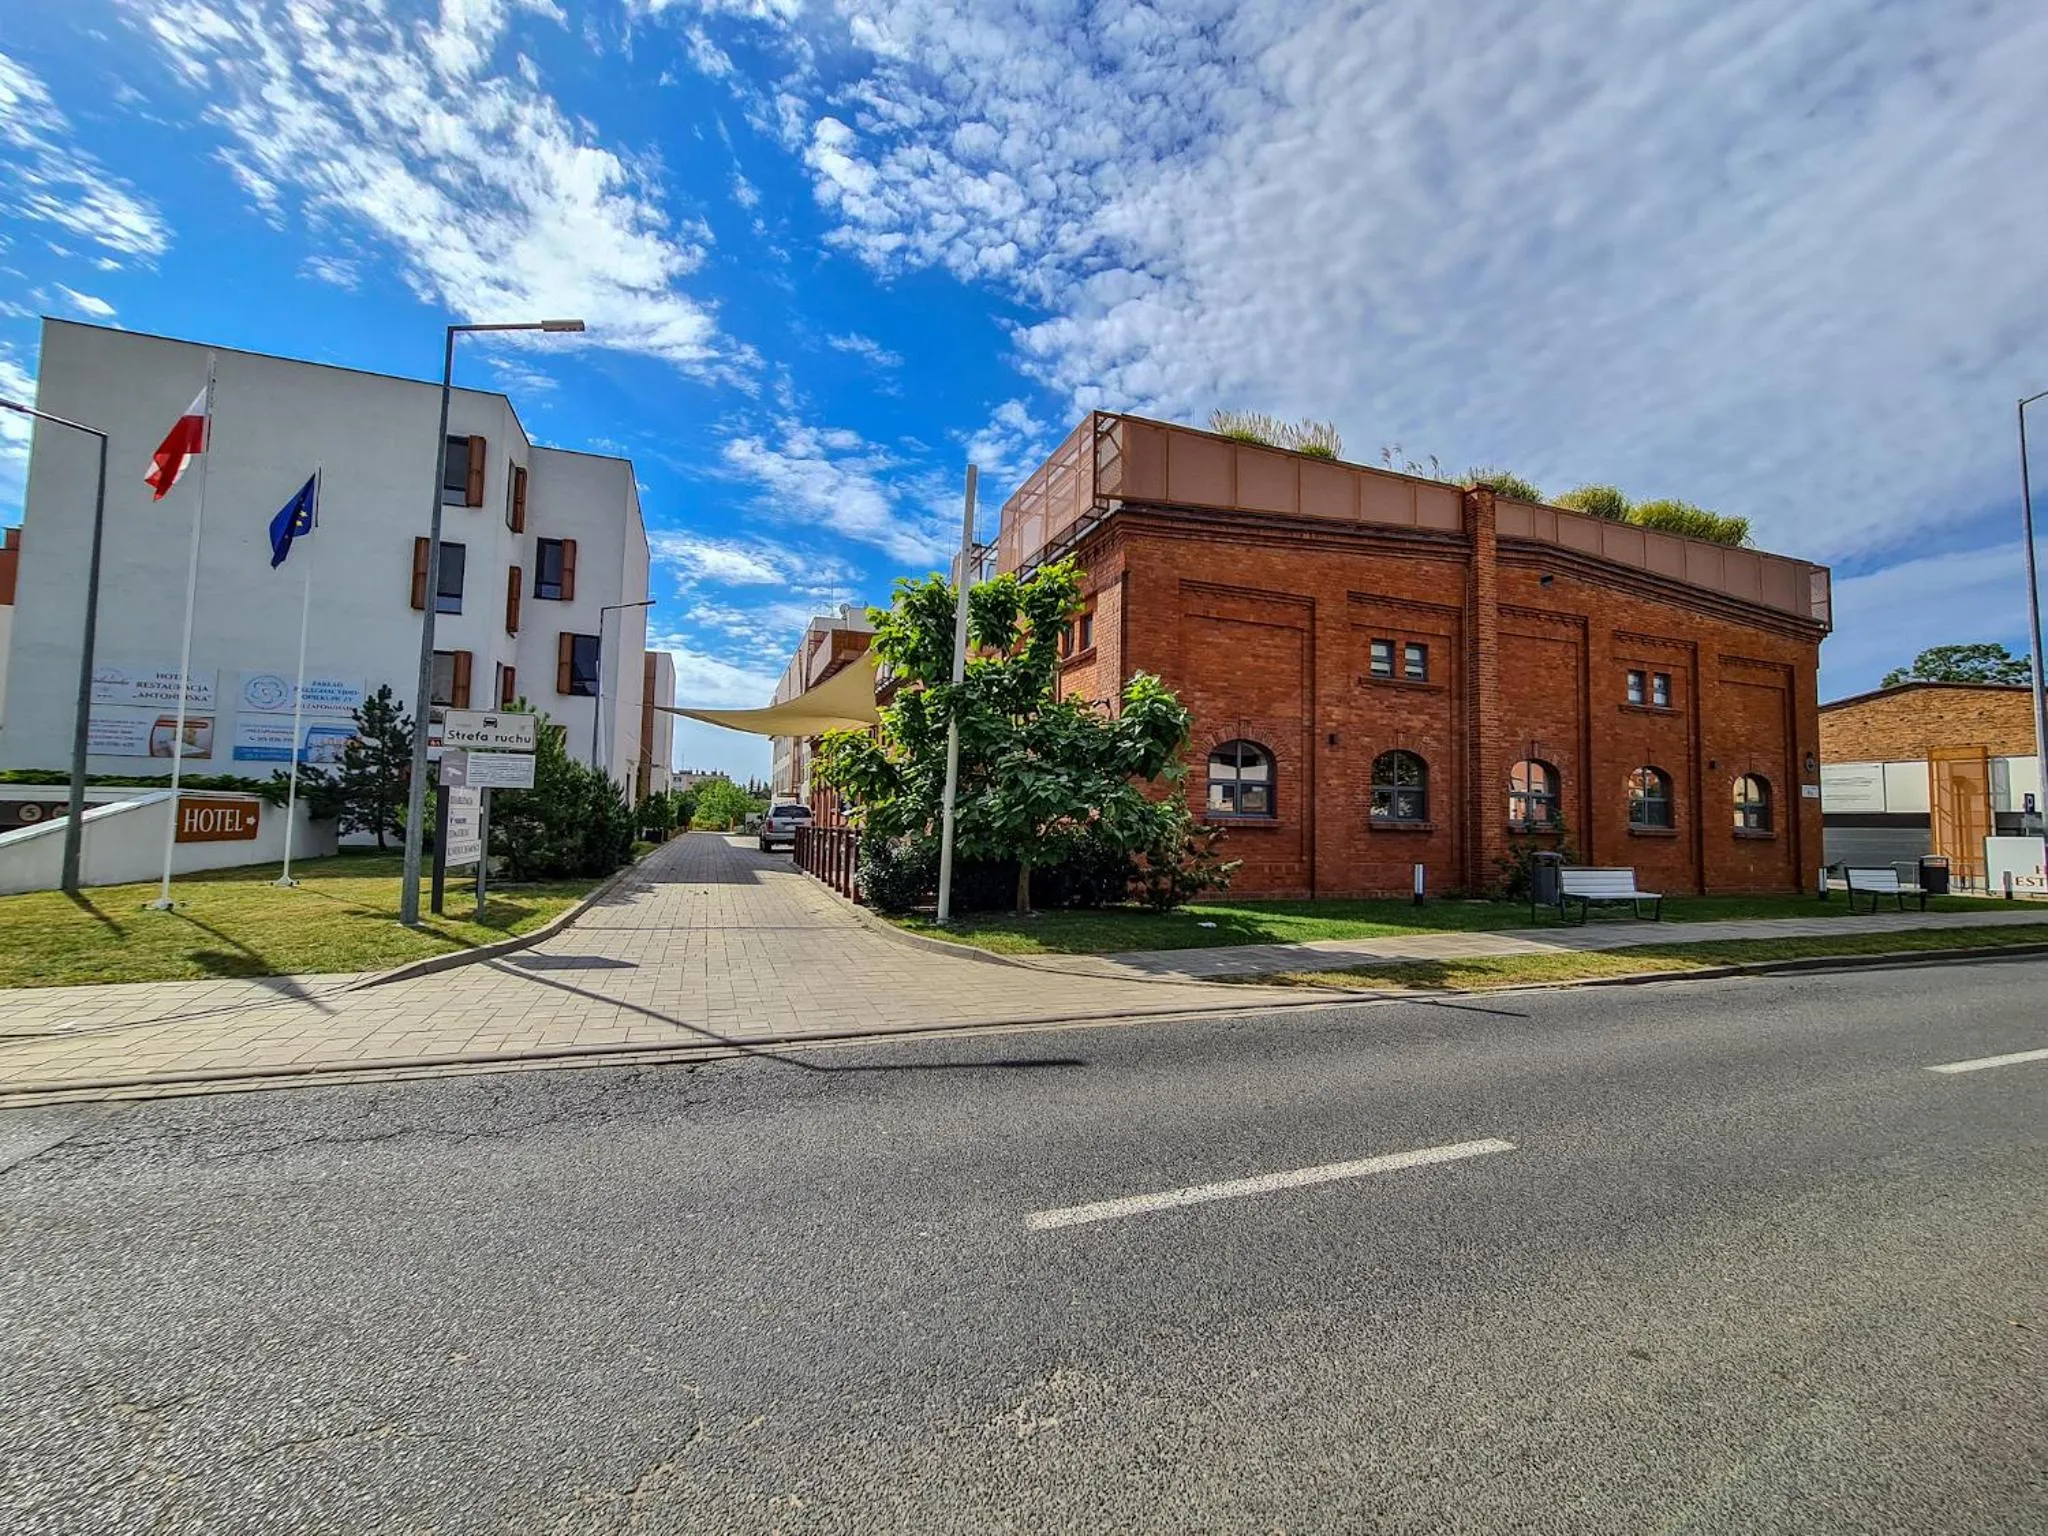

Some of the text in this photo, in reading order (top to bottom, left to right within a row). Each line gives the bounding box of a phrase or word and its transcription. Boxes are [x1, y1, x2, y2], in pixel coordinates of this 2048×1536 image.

[156, 671, 191, 682] HOTL
[447, 729, 532, 744] Strefa ruchu
[183, 807, 244, 833] HOTEL
